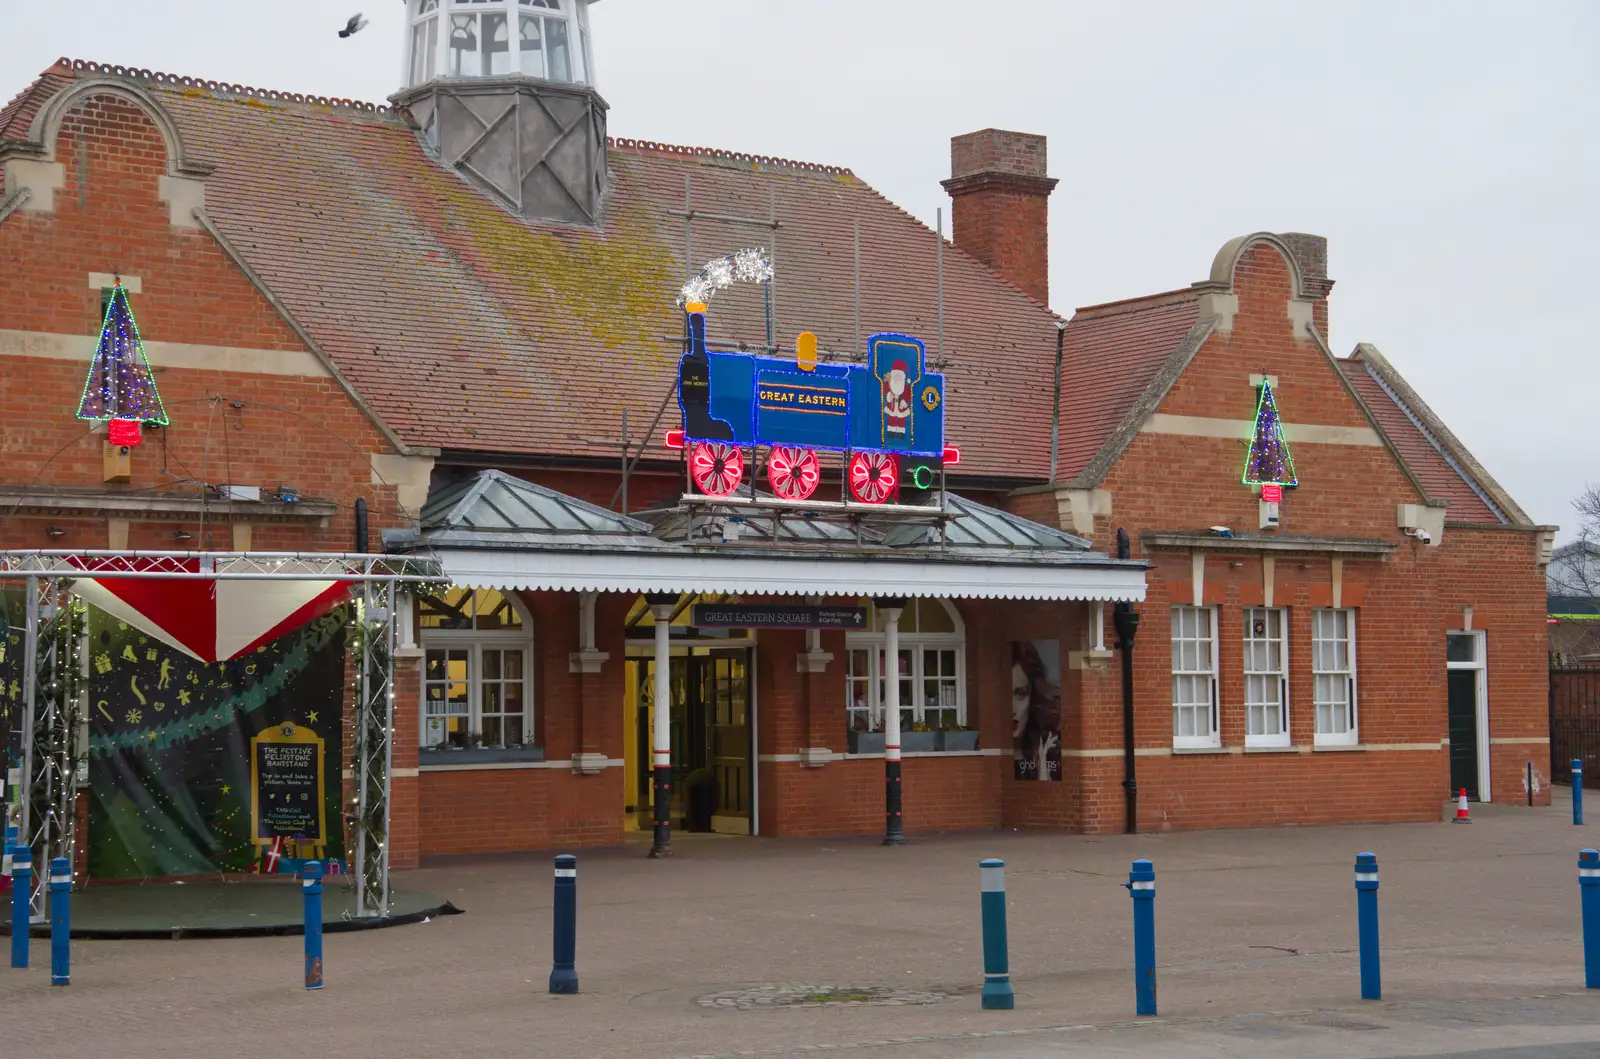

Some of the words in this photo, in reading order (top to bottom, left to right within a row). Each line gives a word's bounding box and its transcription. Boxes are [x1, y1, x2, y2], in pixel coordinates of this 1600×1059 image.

[759, 391, 794, 402] GREAT
[798, 394, 846, 407] EASTERN
[705, 612, 733, 622] GREAT
[736, 612, 775, 622] EASTERN
[777, 613, 812, 624] SQUARE
